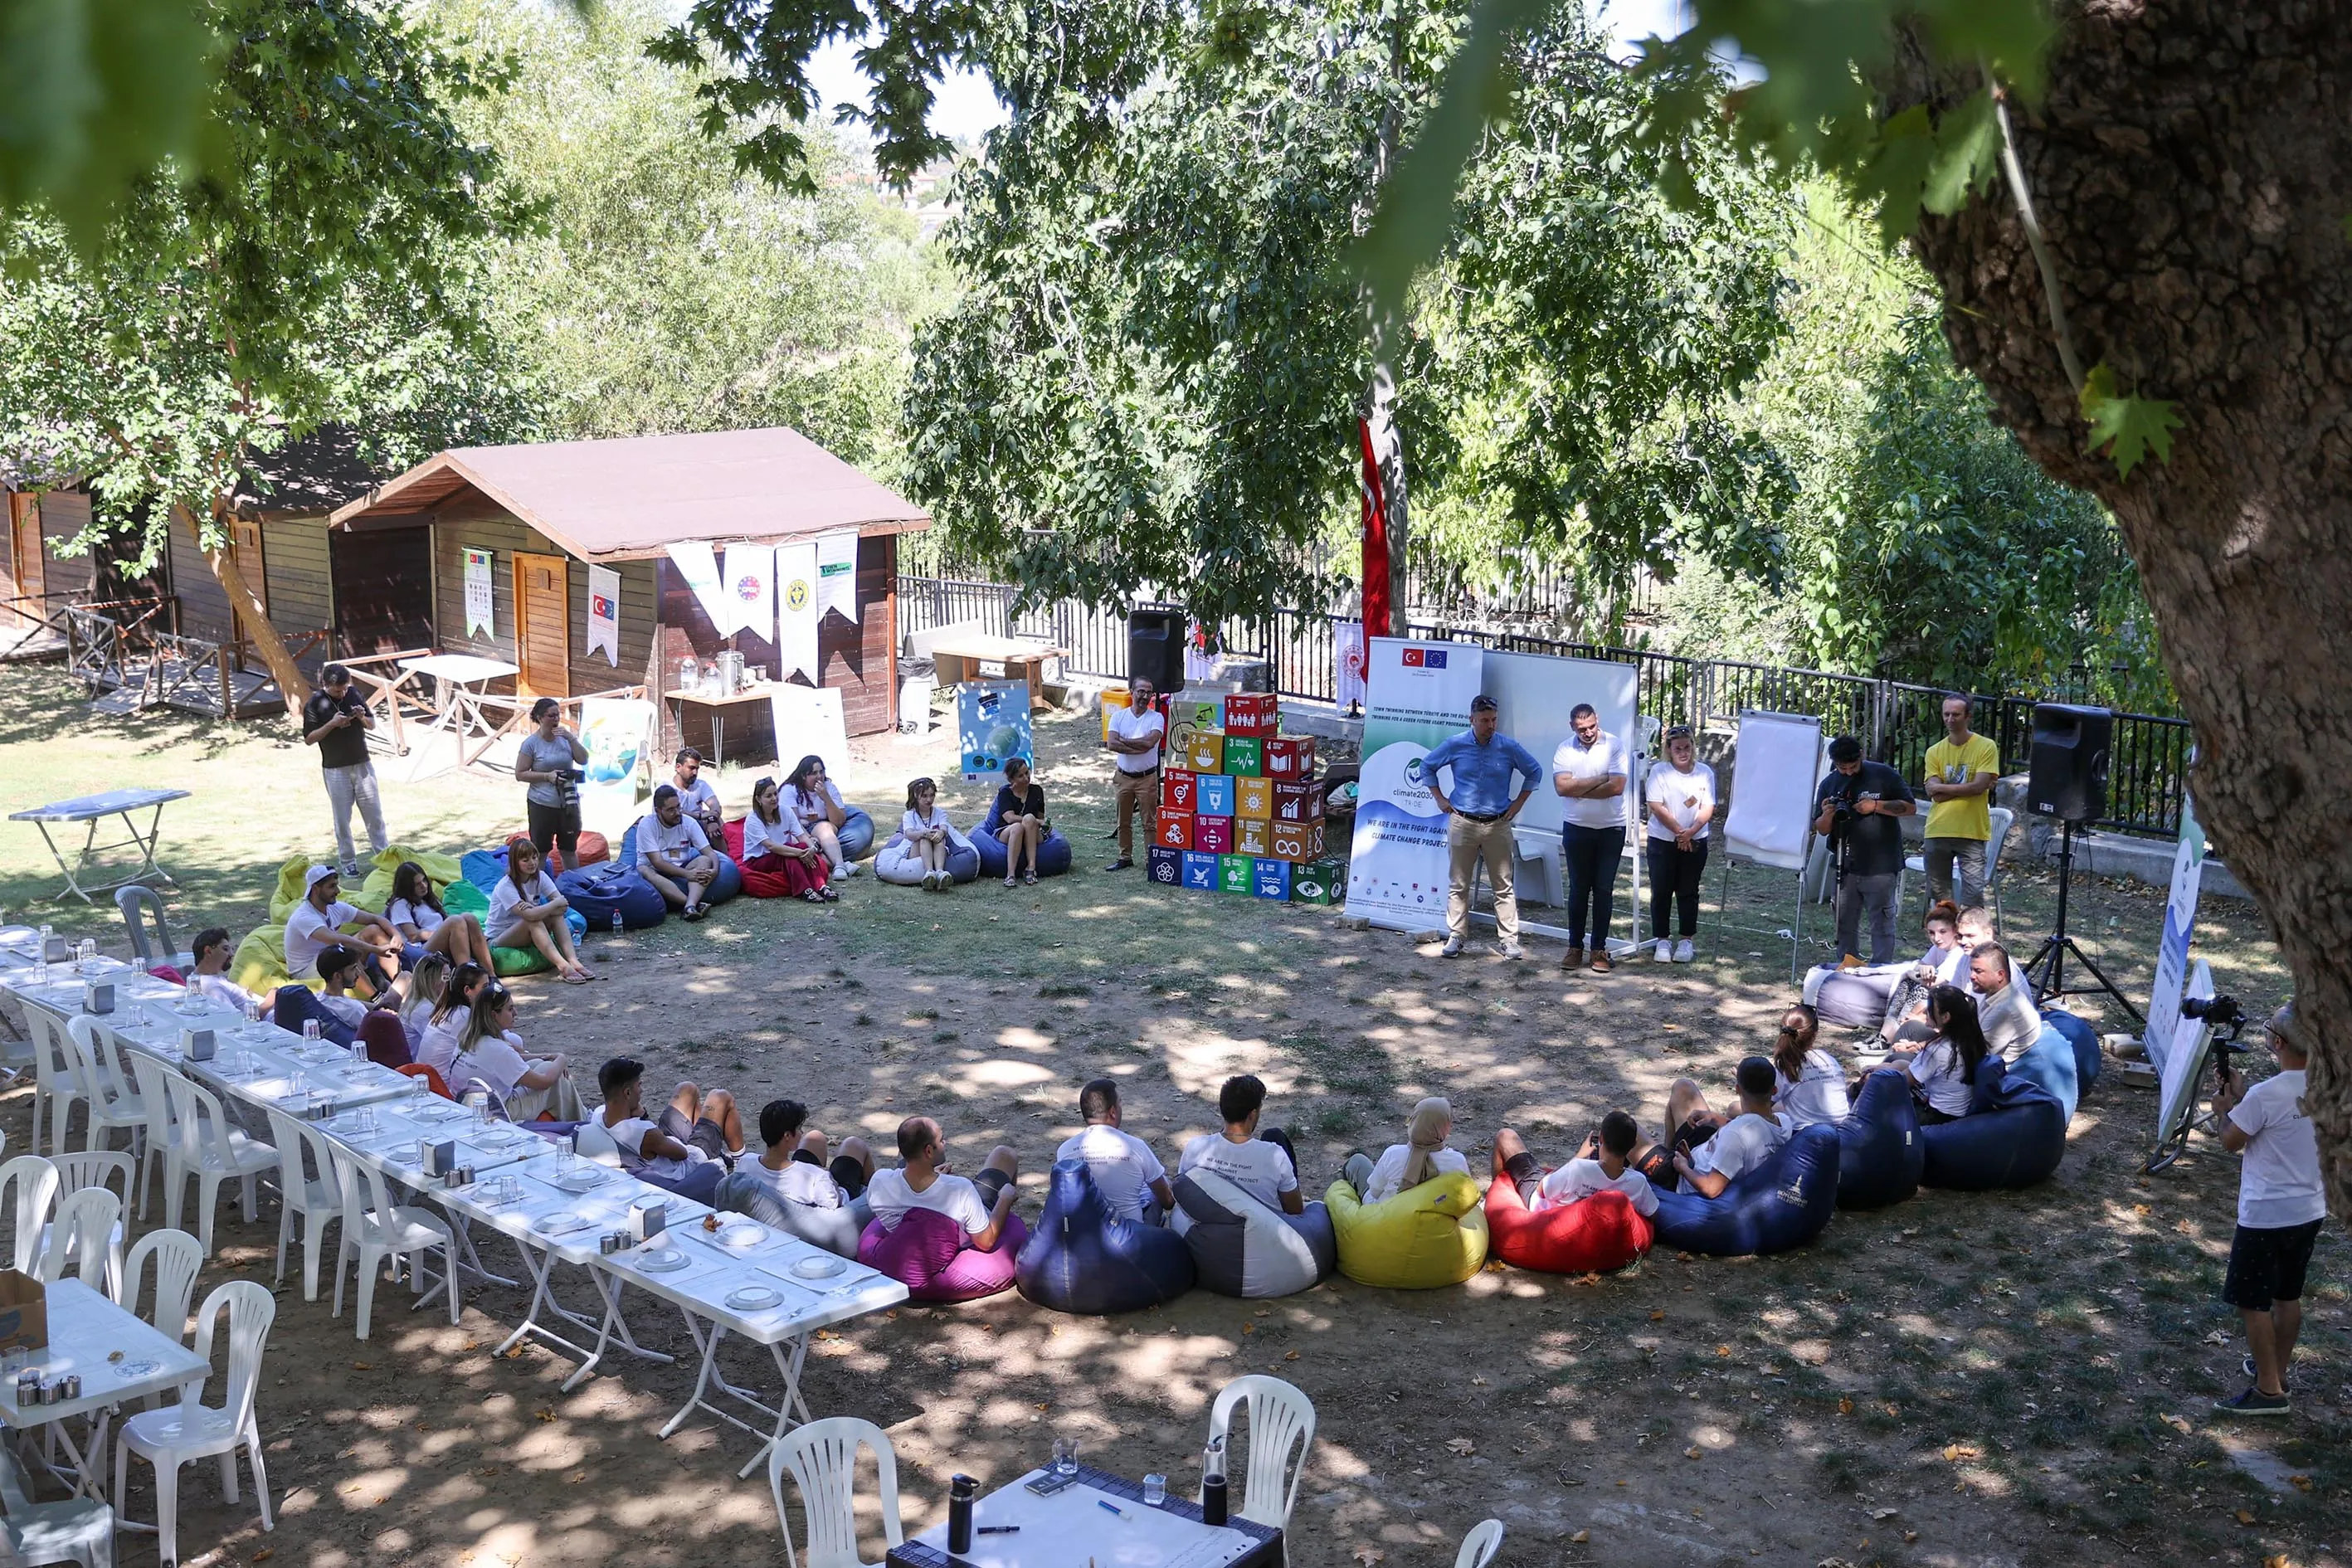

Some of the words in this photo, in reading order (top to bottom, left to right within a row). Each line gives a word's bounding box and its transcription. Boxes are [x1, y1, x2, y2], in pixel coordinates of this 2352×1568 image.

[1227, 699, 1231, 708] 1
[1191, 734, 1196, 744] 2
[1229, 738, 1234, 747] 3
[1266, 741, 1271, 751] 4
[1168, 771, 1174, 781] 5
[1200, 777, 1205, 787] 6
[1239, 778, 1244, 788] 7
[1276, 783, 1282, 794] 8
[1393, 789, 1434, 800] climate2030
[1161, 810, 1166, 820] 9
[1199, 816, 1206, 826] 10
[1238, 819, 1244, 829] 11
[1275, 824, 1283, 834] 12
[1410, 824, 1429, 833] FIGHT
[1429, 826, 1448, 835] AGAIN
[1371, 832, 1395, 842] CLIMATE
[1396, 835, 1421, 845] CHANGE
[1422, 838, 1448, 849] PROJECT
[1152, 848, 1158, 858] 17
[1186, 853, 1194, 863] 16
[1223, 857, 1231, 867] 15
[1257, 862, 1264, 872] 14
[1298, 865, 1305, 875] 13
